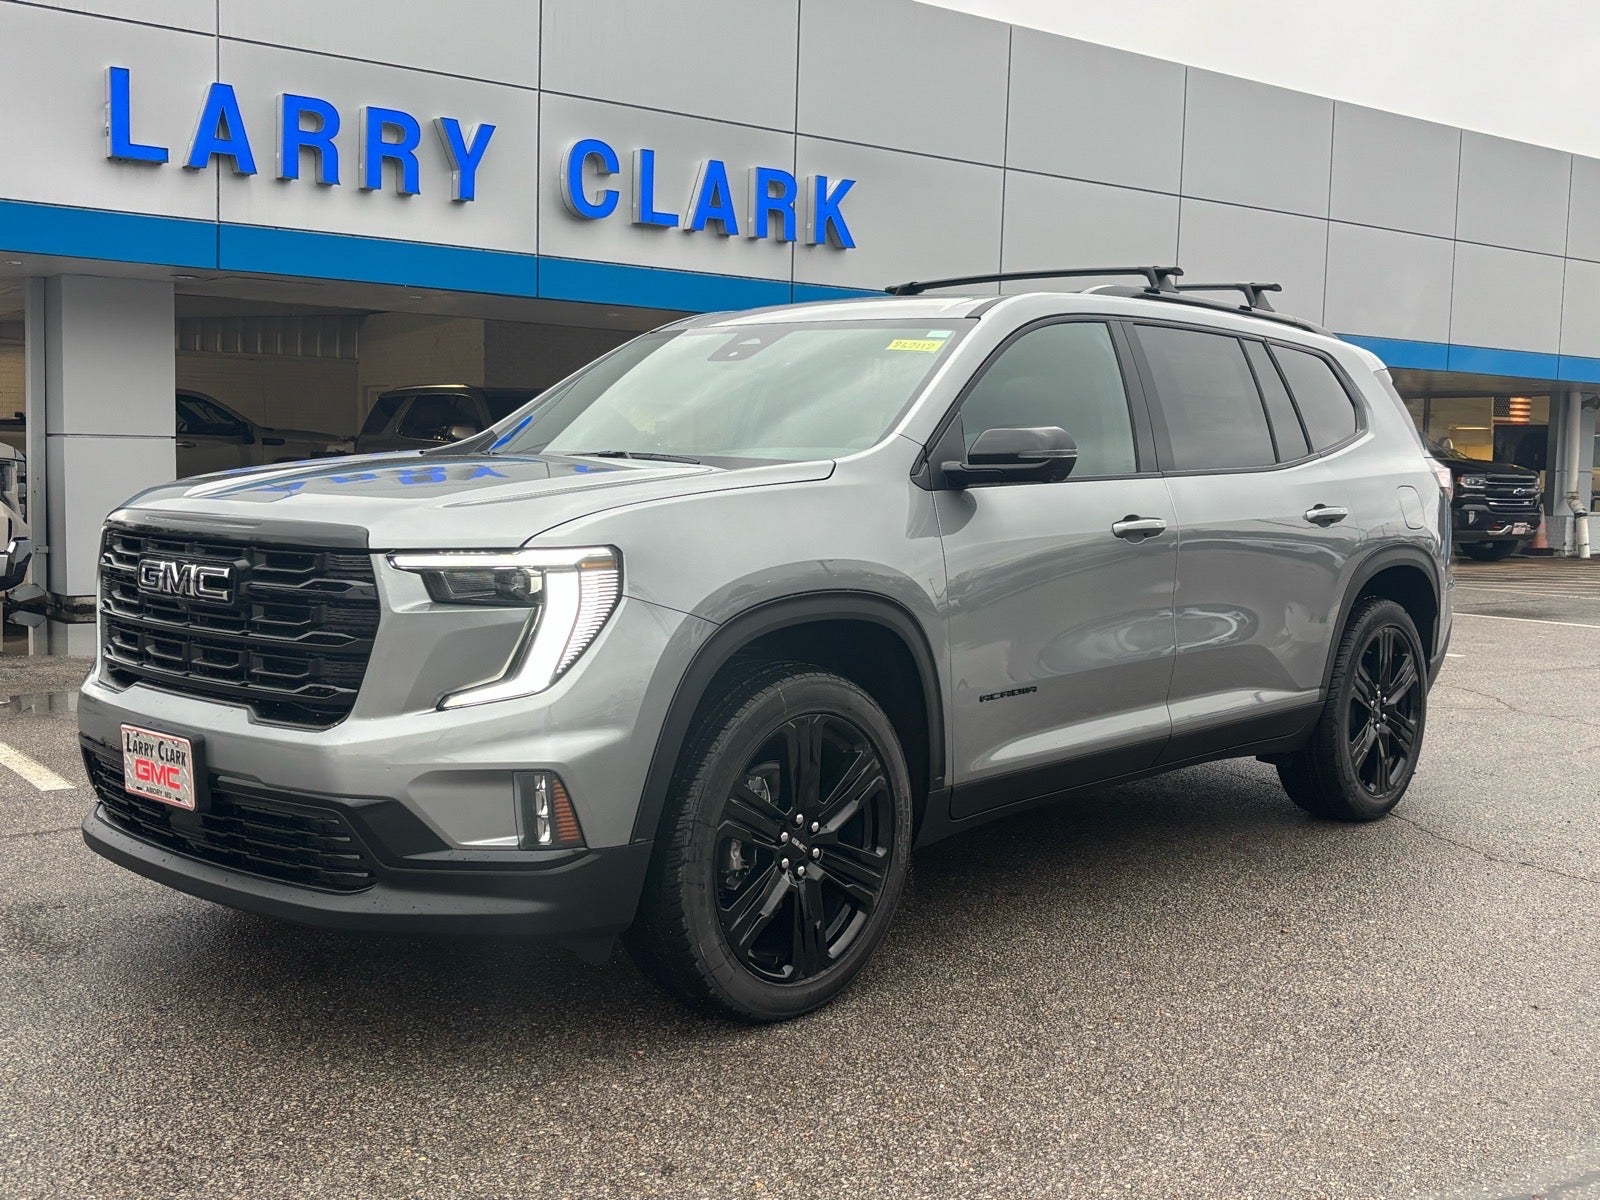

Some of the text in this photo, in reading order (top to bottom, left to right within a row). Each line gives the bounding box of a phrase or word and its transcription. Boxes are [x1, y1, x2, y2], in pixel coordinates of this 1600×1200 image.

[105, 65, 857, 250] LARRY CLARK
[137, 558, 231, 601] GMC
[979, 686, 1038, 702] ACADIA
[126, 733, 186, 767] LARRY CLARK
[136, 758, 181, 790] GMC
